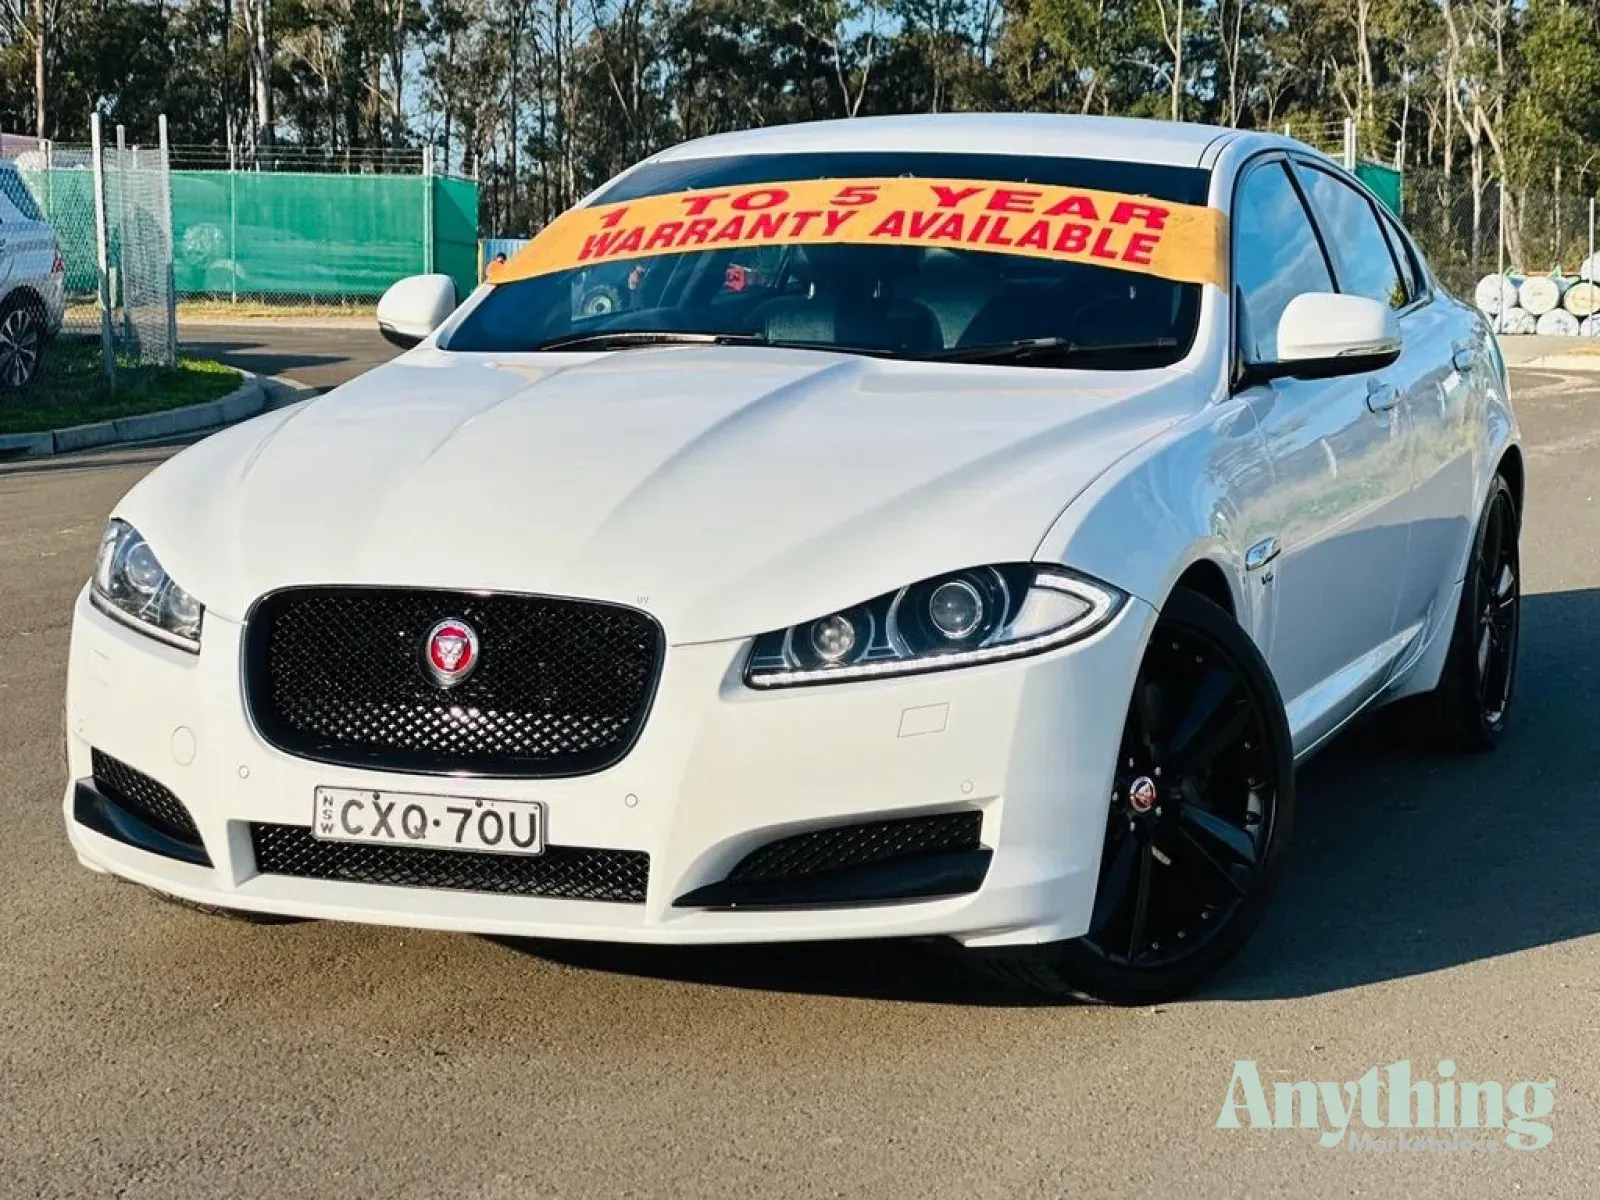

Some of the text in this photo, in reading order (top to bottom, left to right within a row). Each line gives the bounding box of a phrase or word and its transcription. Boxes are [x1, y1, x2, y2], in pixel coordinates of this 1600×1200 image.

[599, 185, 1171, 230] 1 TO 5 YEAR
[576, 210, 1161, 265] WARRANTY AVAILABLE
[320, 795, 334, 834] NSW
